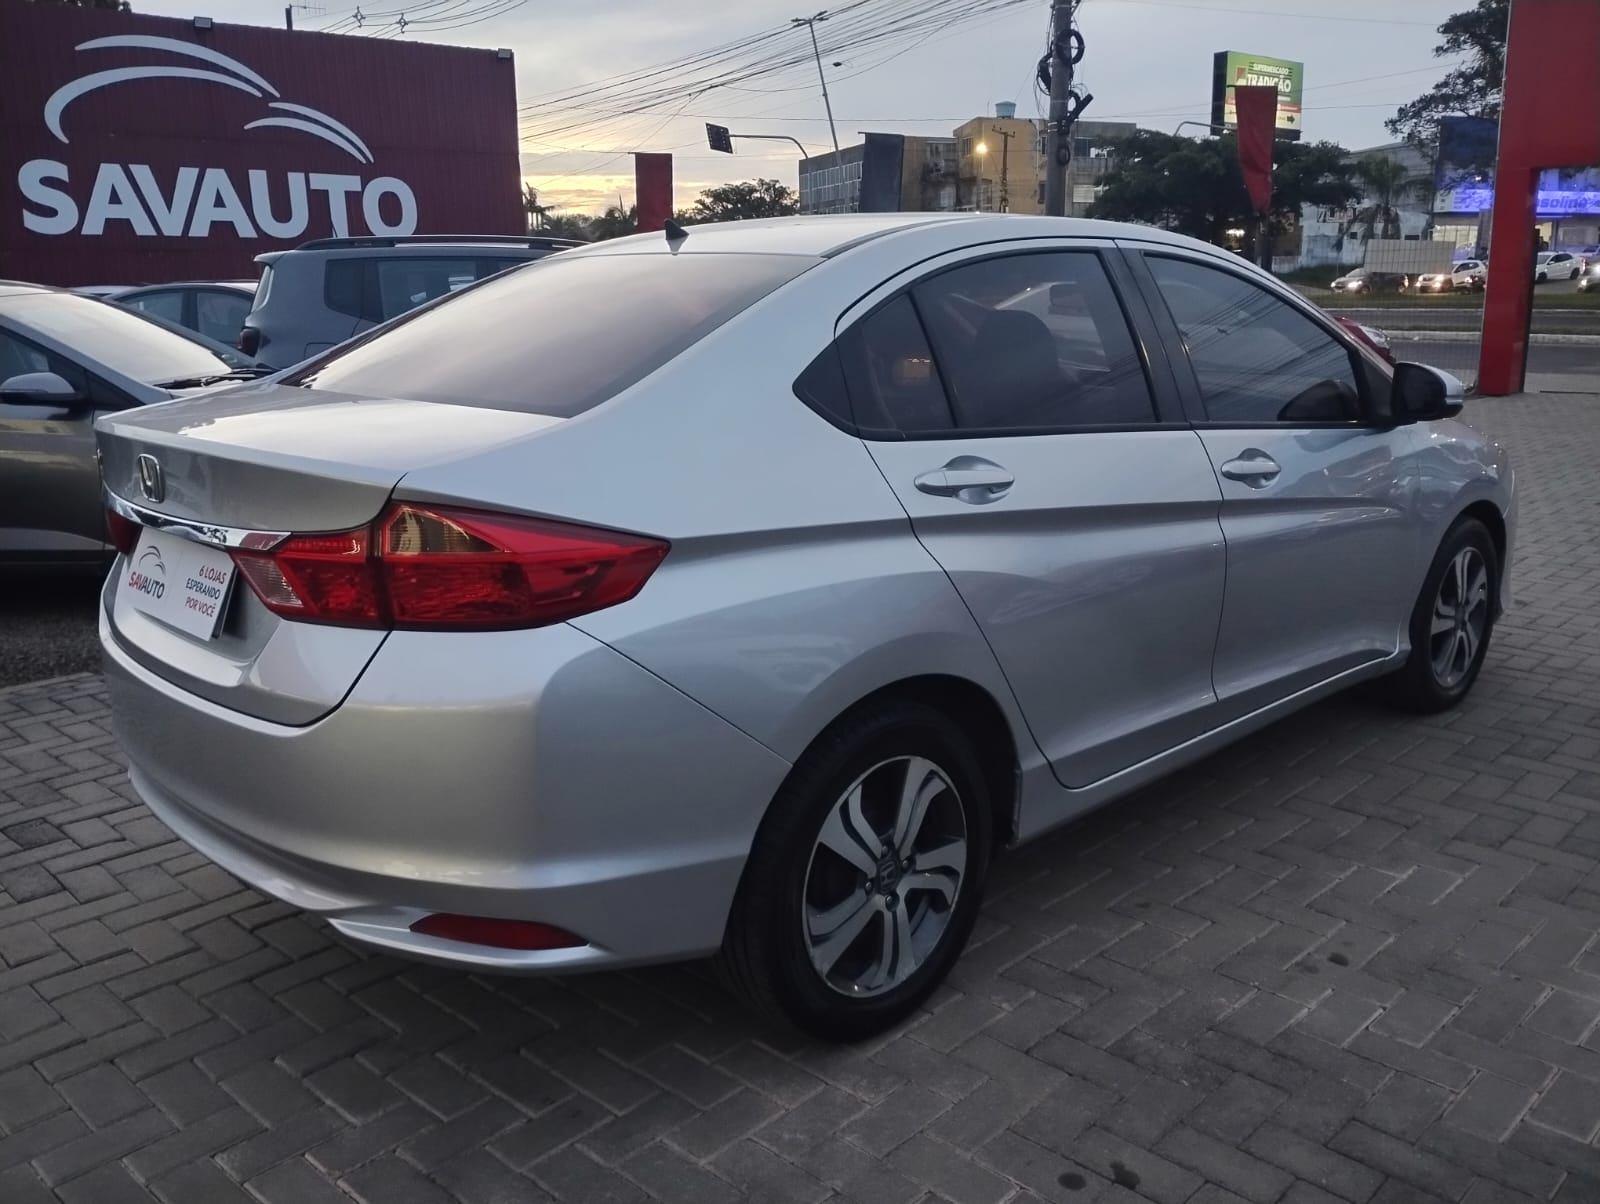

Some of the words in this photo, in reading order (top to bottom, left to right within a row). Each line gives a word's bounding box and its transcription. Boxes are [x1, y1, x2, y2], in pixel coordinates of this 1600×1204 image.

[17, 158, 419, 239] SAVAUTO
[128, 571, 165, 598] SAVAUTO
[199, 566, 204, 577] 6
[204, 567, 226, 584] LOJAS
[186, 578, 220, 599] ESPERANDO
[185, 597, 198, 610] POR
[198, 602, 215, 617] VOCÊ
